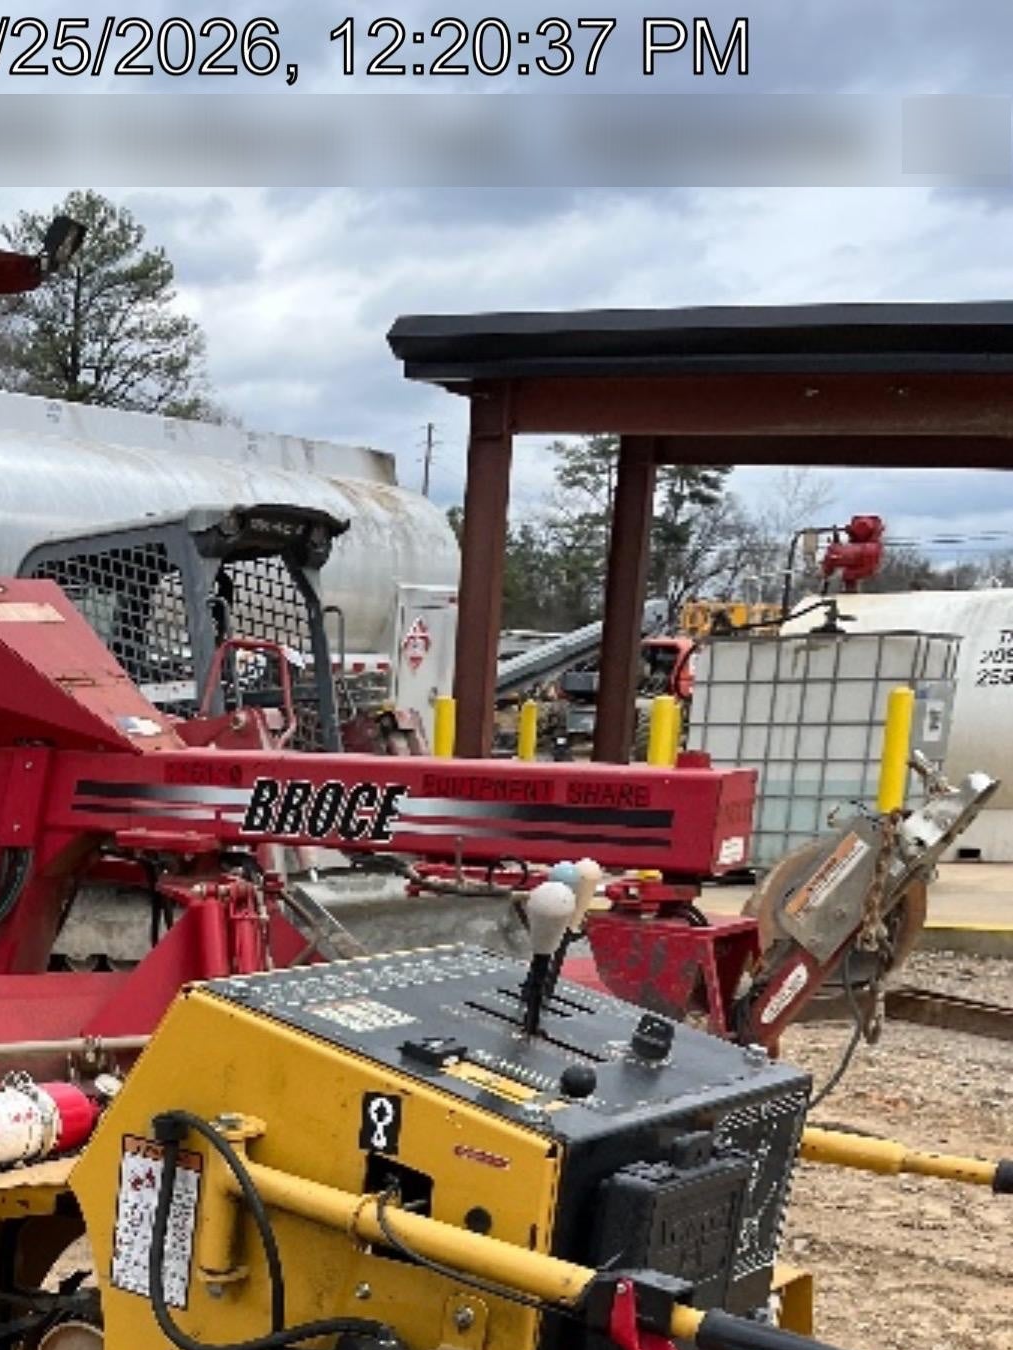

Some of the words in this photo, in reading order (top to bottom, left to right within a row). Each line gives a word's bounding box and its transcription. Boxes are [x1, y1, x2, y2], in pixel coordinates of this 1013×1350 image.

[239, 776, 411, 843] BROCE
[421, 773, 556, 803] EQUIPMENT
[565, 780, 653, 808] SHARE
